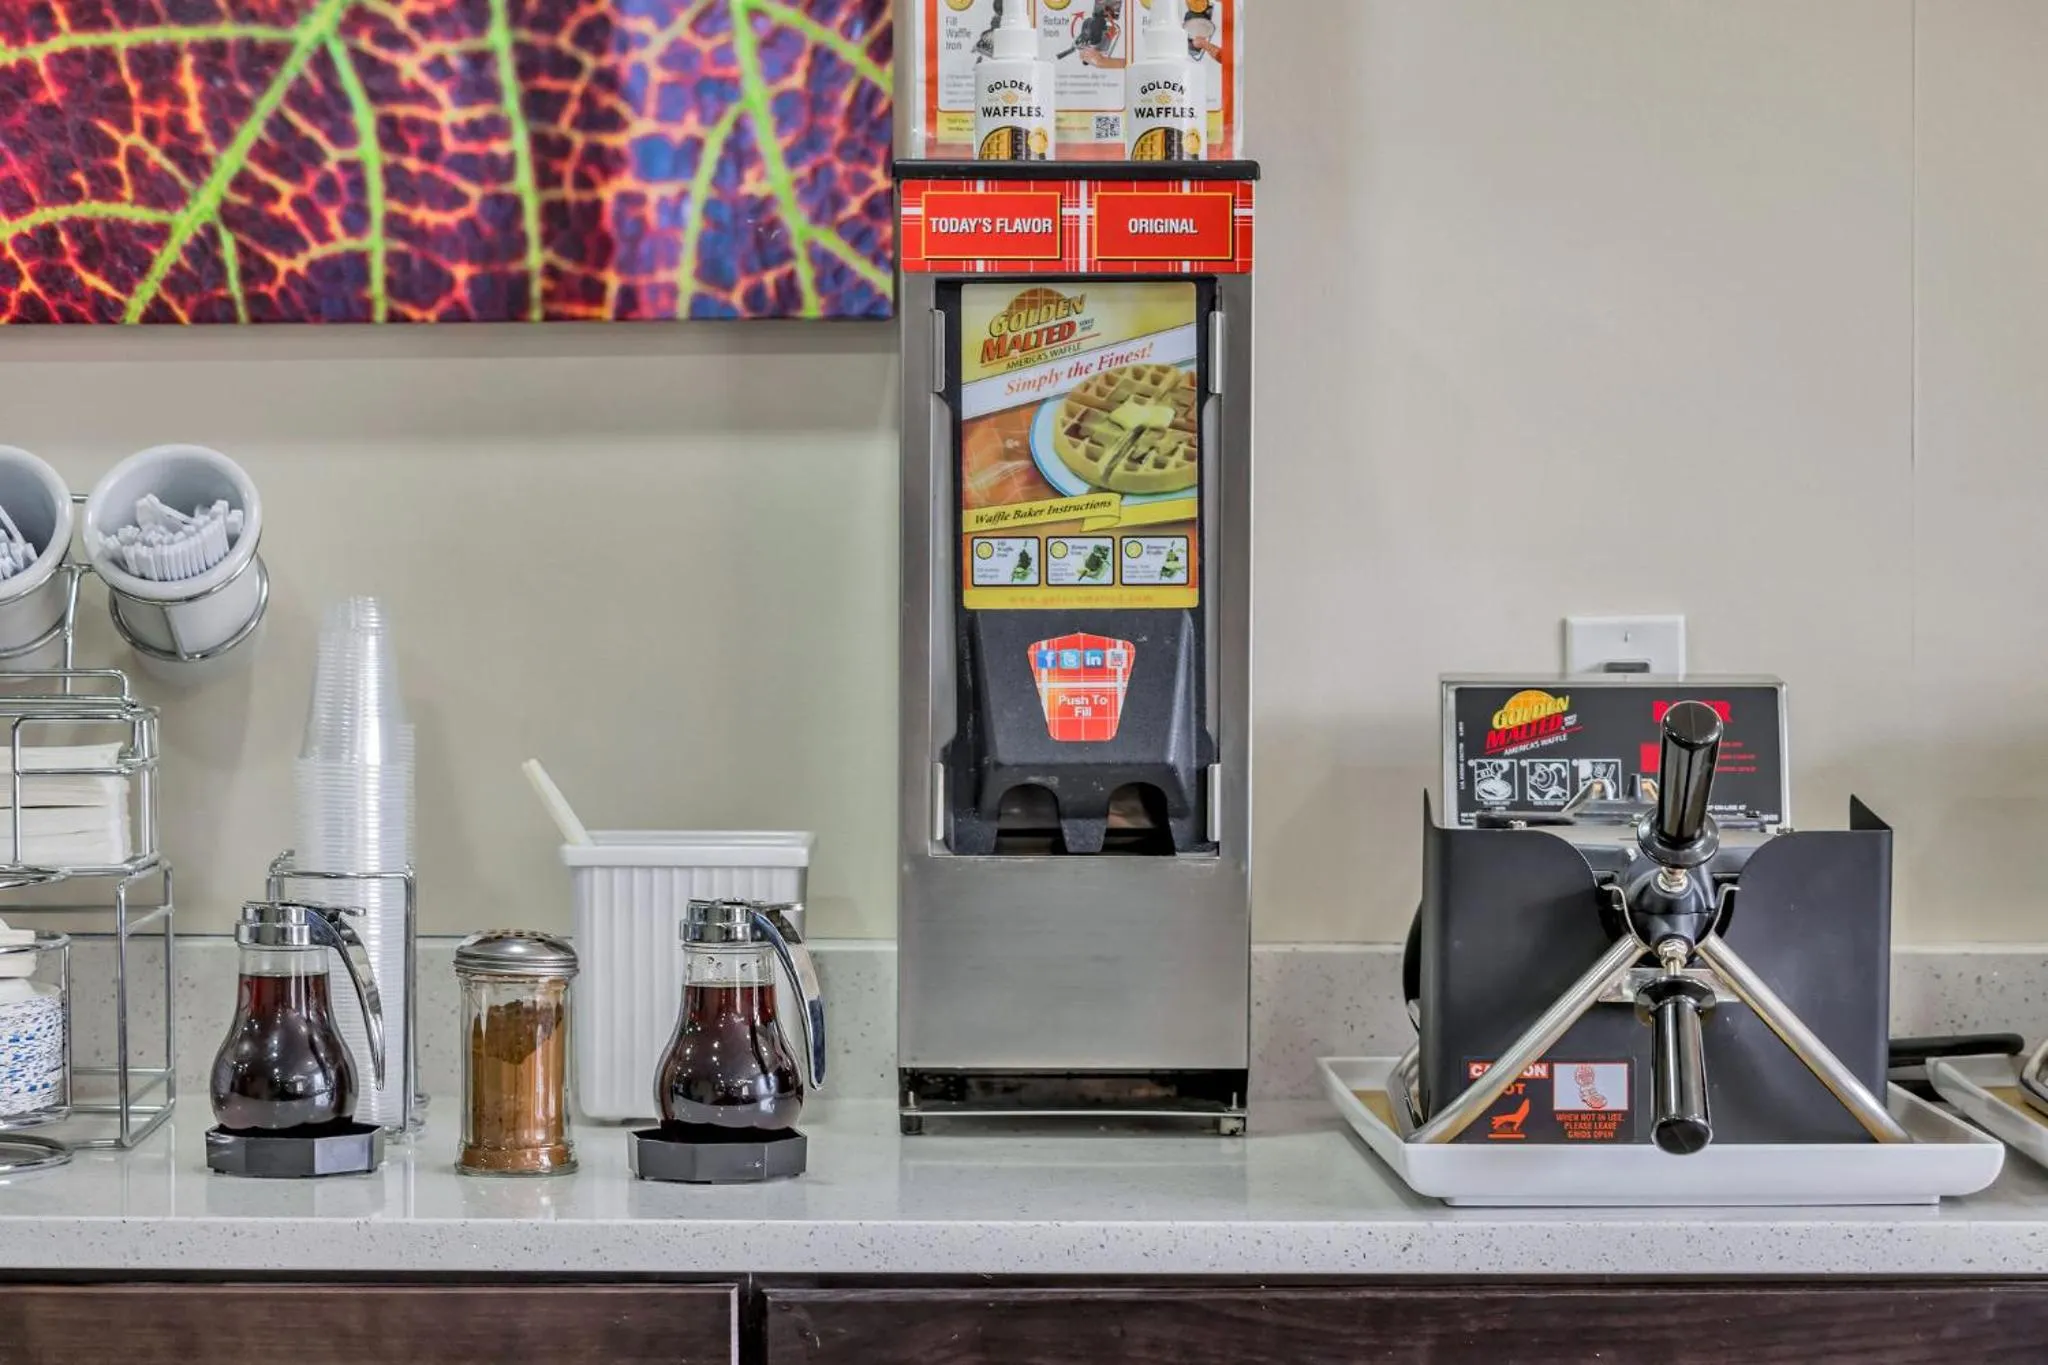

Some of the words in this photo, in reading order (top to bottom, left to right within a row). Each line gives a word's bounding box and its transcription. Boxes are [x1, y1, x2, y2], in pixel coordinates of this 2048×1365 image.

[1043, 15, 1069, 26] Rotate
[945, 28, 971, 38] Waffle
[1043, 27, 1060, 37] Iron
[945, 41, 962, 51] Iron
[987, 80, 1033, 94] GOLDEN
[1140, 81, 1185, 95] GOLDEN
[929, 217, 992, 234] TODAY'S
[996, 217, 1053, 233] FLAVOR
[1128, 217, 1198, 234] ORIGINAL
[989, 293, 1087, 338] GOLDEN
[980, 320, 1077, 364] MALTED
[1006, 352, 1049, 370] AMERICA'S
[1050, 342, 1082, 358] WAFFLE
[1005, 368, 1062, 396] Simply
[1067, 361, 1093, 377] the
[1098, 342, 1154, 371] Finest!
[975, 511, 1011, 525] Waffle
[1013, 508, 1045, 520] Baker
[1047, 499, 1112, 515] Instructions
[1059, 695, 1089, 706] Push
[1092, 695, 1108, 705] To
[1074, 706, 1092, 718] Fill
[1502, 1083, 1527, 1096] OT
[1581, 1113, 1596, 1122] NOT
[1564, 1122, 1592, 1130] PLEASE
